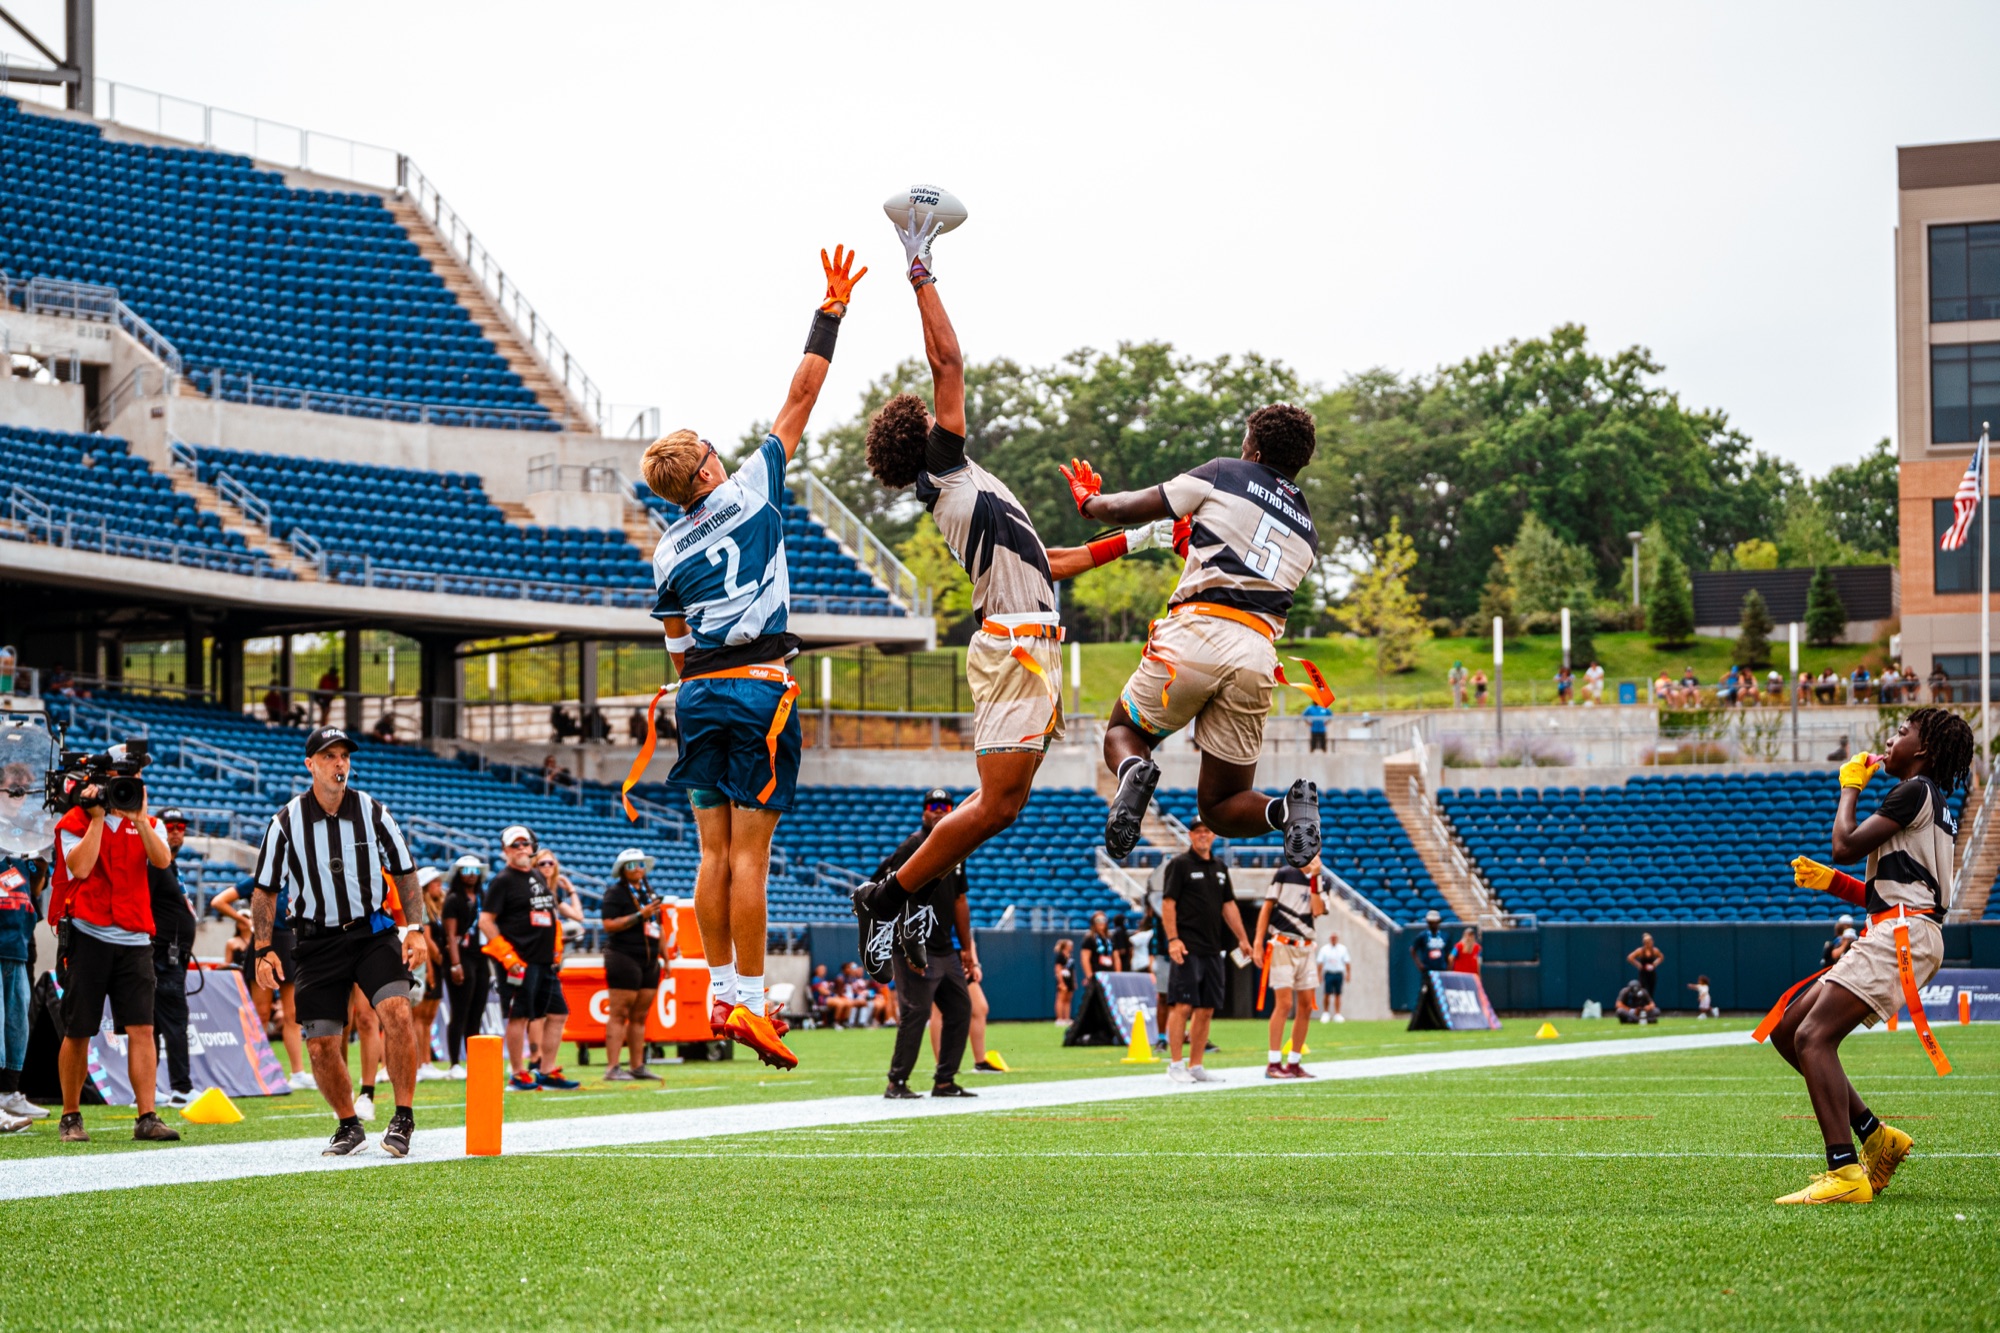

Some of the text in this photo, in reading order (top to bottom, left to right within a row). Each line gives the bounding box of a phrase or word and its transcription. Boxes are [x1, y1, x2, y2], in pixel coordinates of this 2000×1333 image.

[914, 195, 939, 205] FLAG
[674, 502, 742, 555] LOCKDOWN LEGENDS
[1246, 480, 1312, 531] METRO SELECT
[705, 535, 760, 601] 2
[1244, 511, 1292, 581] 5
[658, 977, 677, 1028] G
[200, 1031, 239, 1046] TOYOTA
